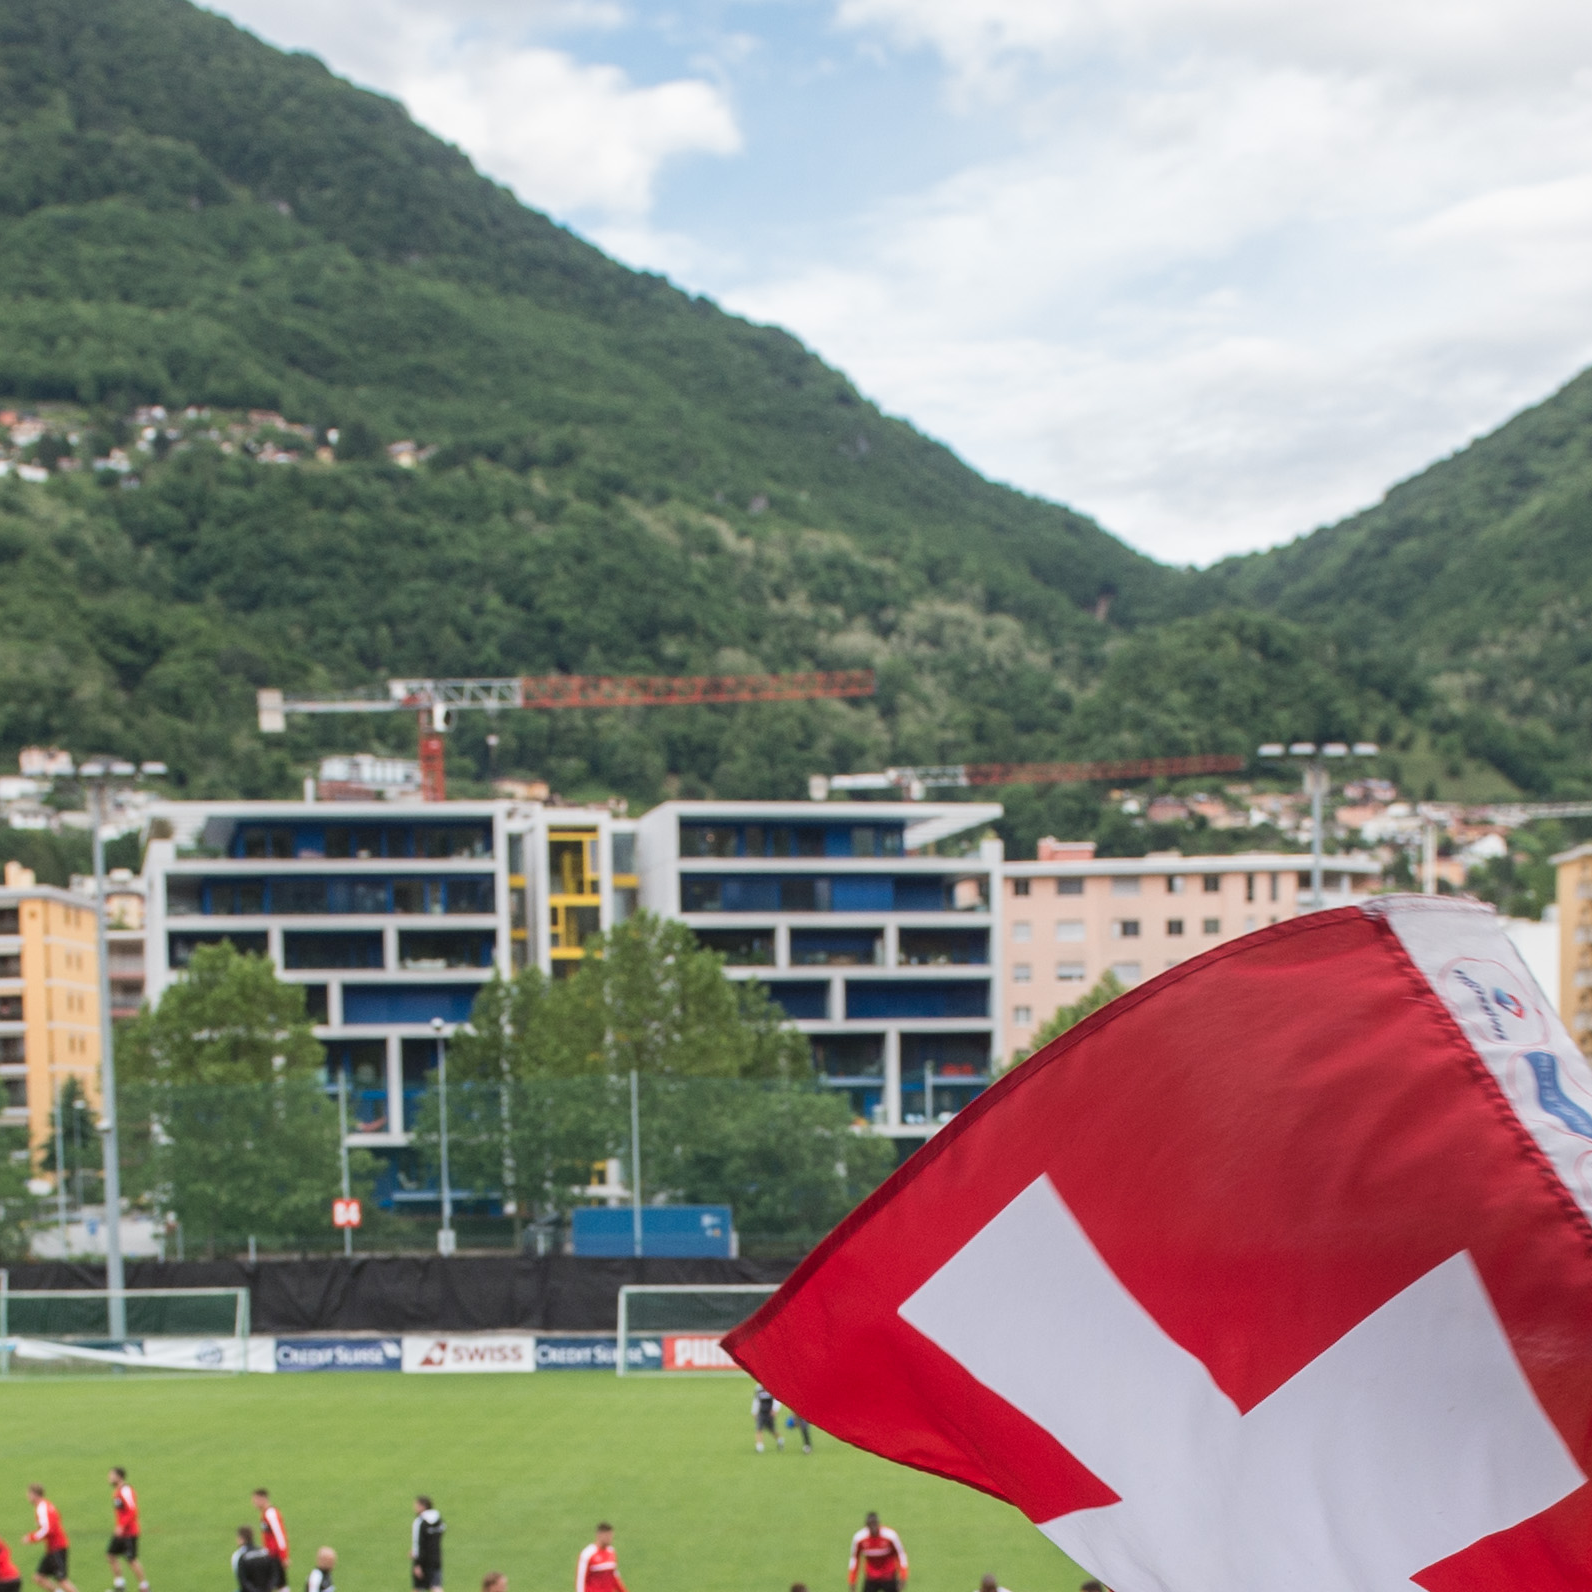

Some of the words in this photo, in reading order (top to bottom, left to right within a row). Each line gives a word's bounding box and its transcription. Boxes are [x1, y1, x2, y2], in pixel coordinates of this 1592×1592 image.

[277, 1346, 333, 1366] CREDIT
[334, 1346, 385, 1365] SUISSE
[452, 1345, 522, 1362] SWISS
